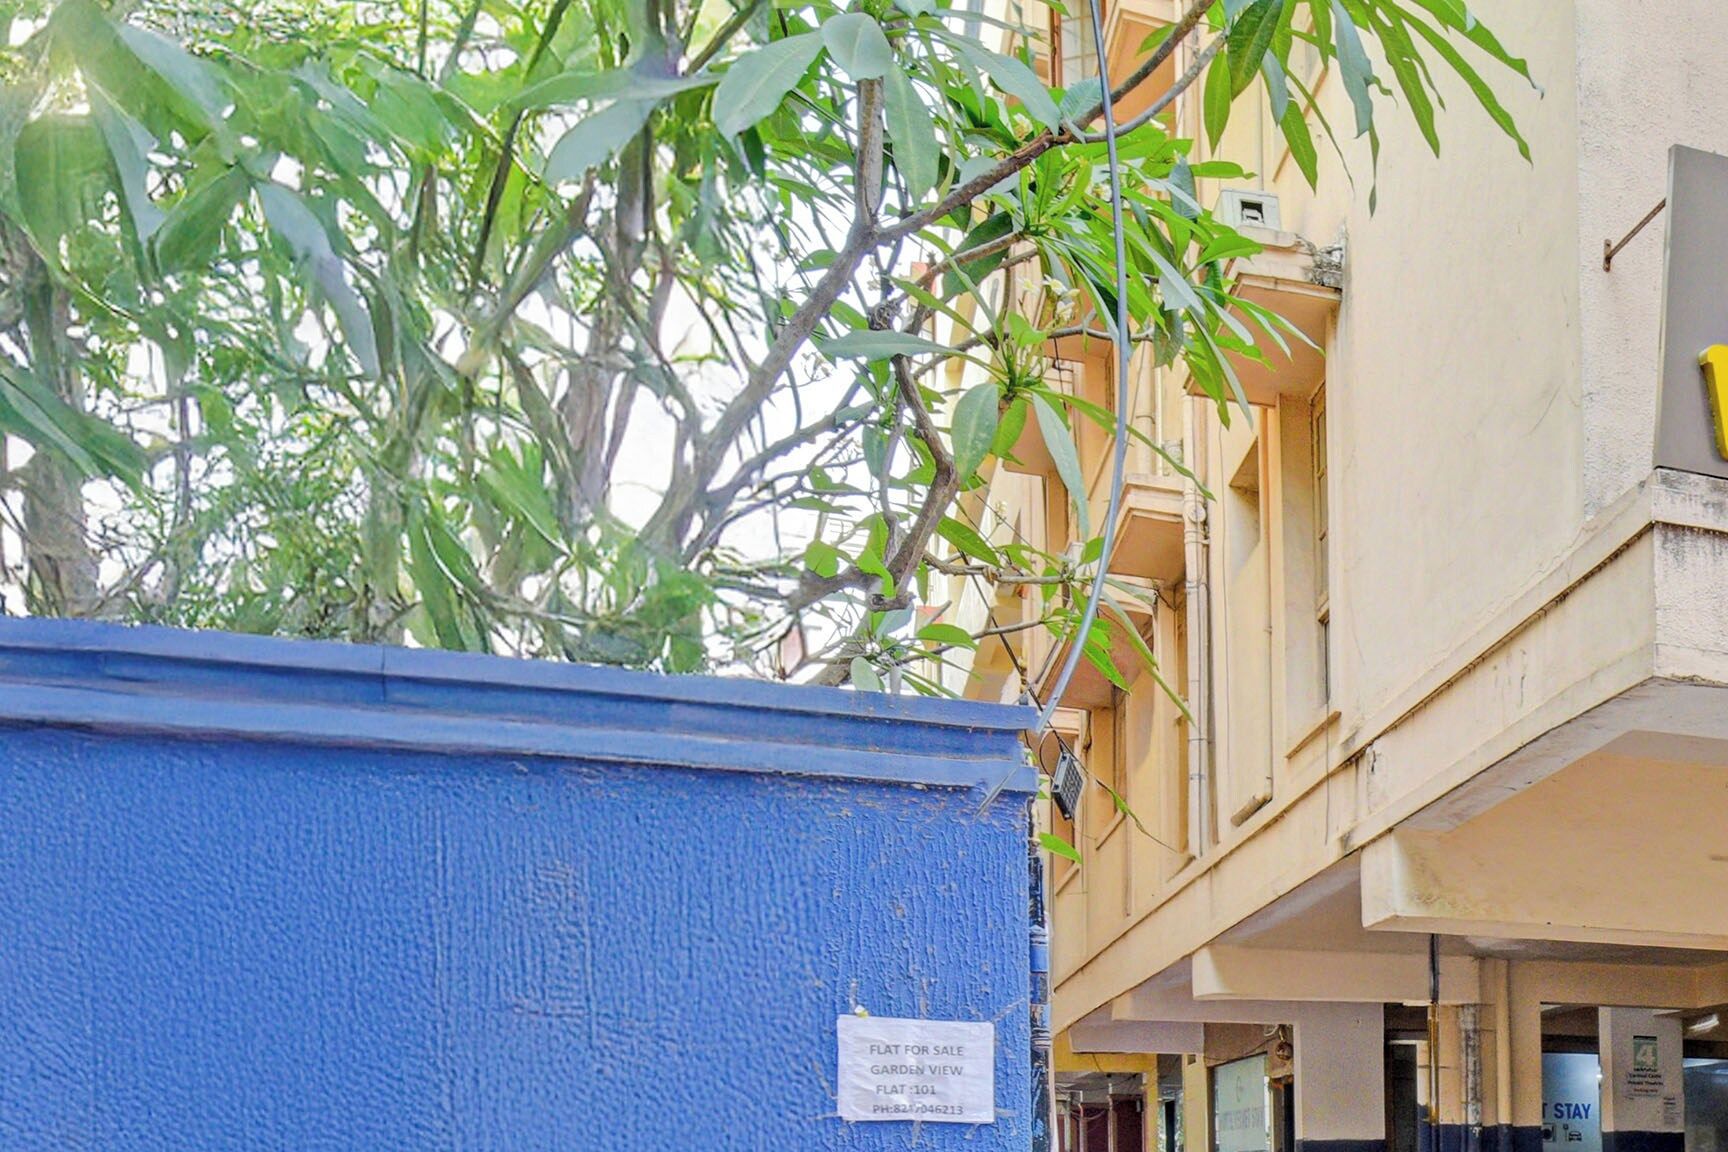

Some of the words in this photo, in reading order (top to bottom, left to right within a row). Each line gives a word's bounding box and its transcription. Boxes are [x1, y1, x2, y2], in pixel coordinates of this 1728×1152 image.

[869, 1044, 900, 1056] FLAT
[904, 1045, 929, 1056] FOR
[933, 1046, 965, 1057] SALE
[870, 1064, 925, 1076] GARDEN
[928, 1065, 964, 1076] VIEW
[876, 1084, 906, 1095] FLAT
[1554, 1102, 1591, 1121] STAY
